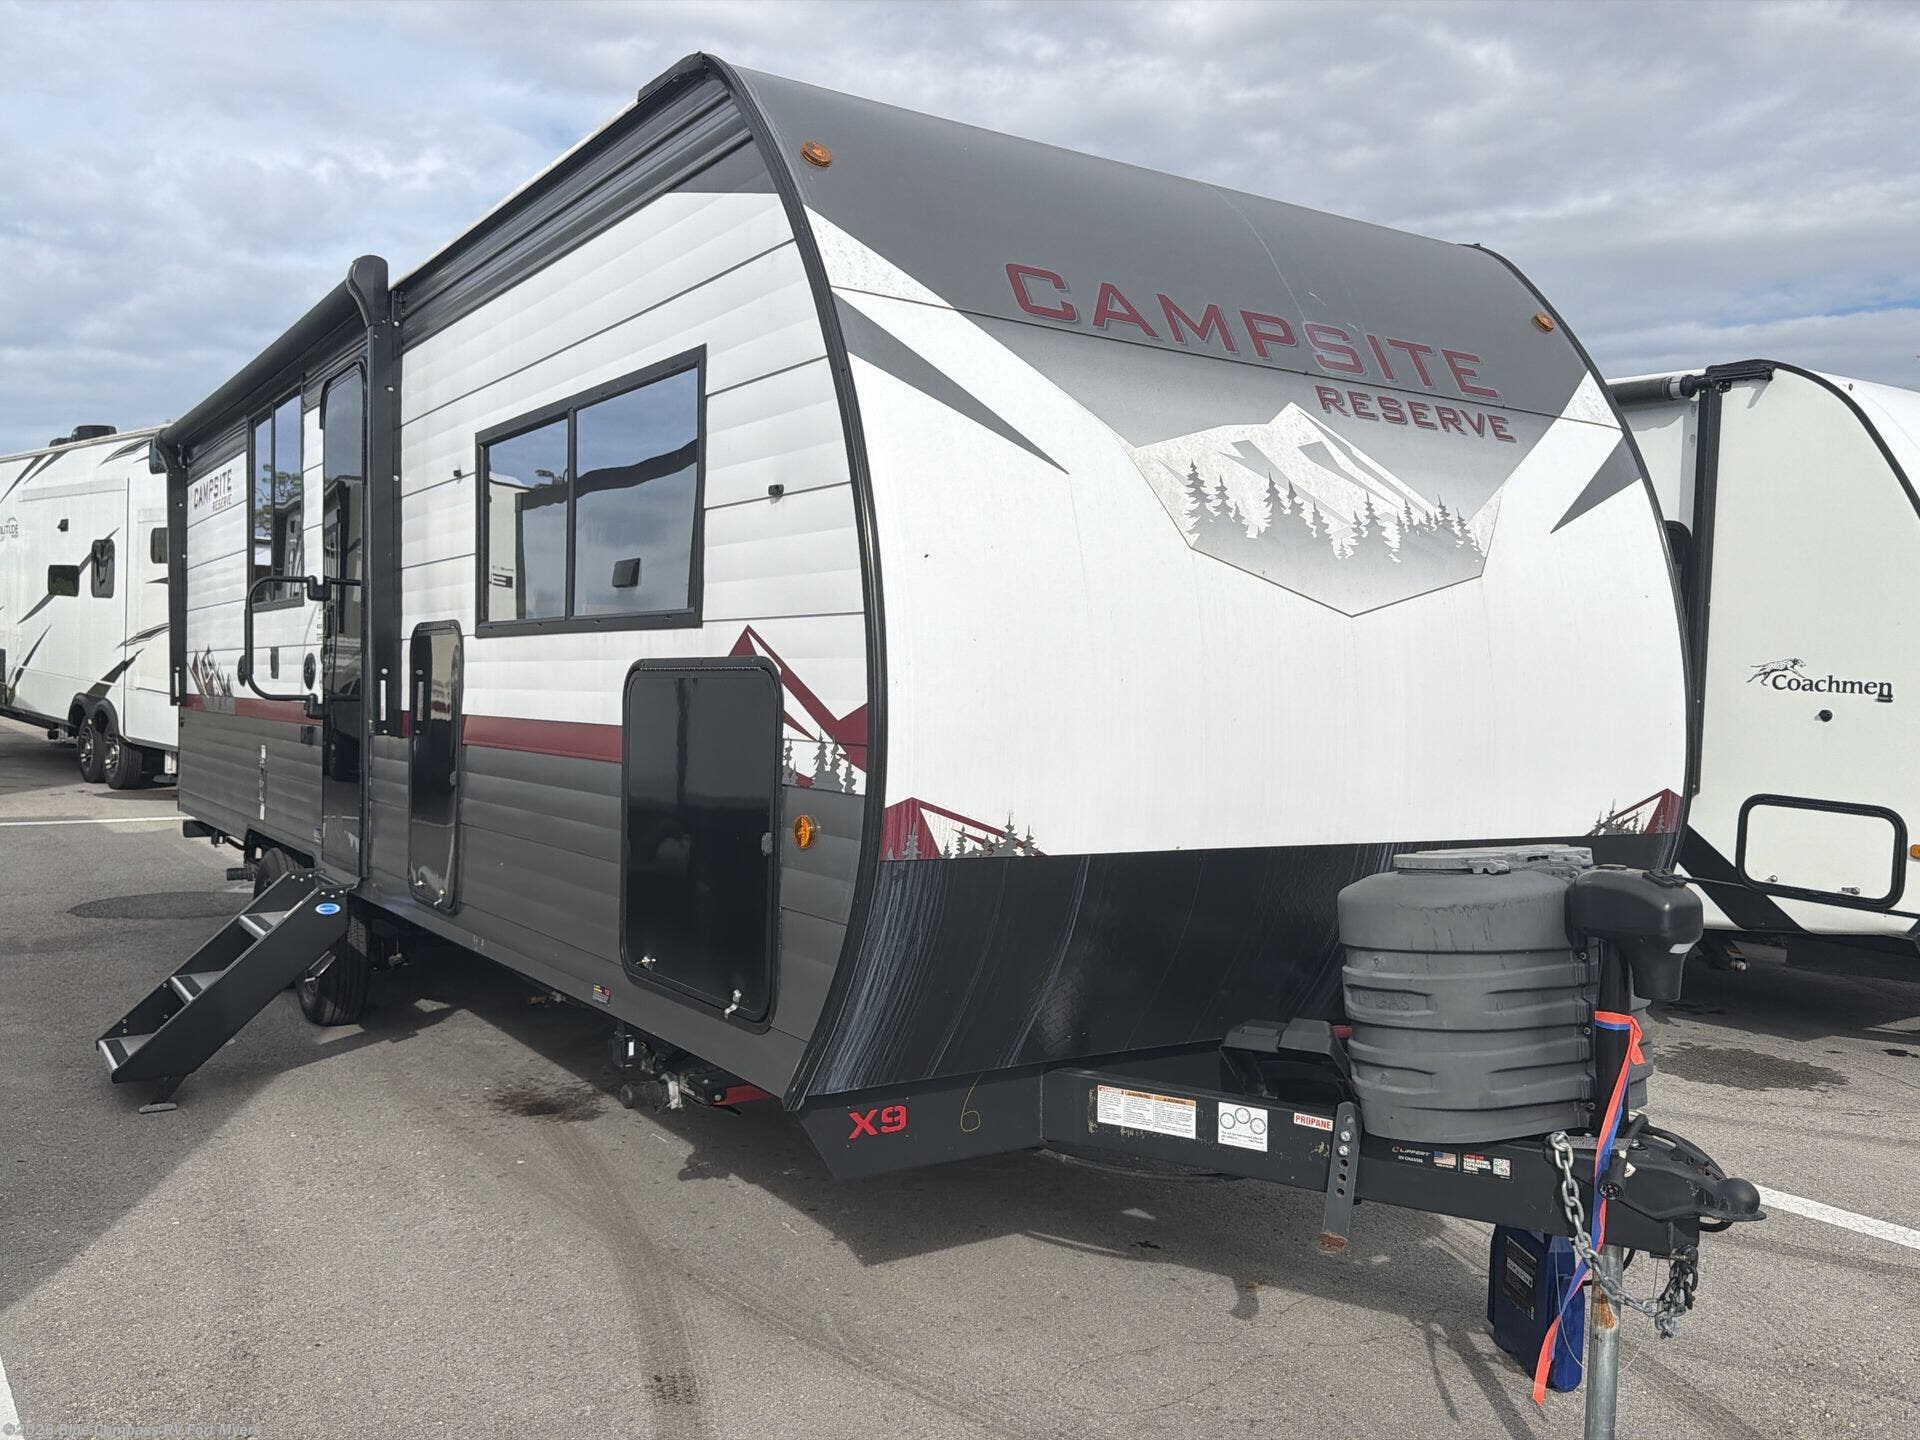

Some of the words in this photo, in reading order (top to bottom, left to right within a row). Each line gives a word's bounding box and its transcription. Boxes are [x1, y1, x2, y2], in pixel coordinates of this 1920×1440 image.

[1005, 263, 1500, 399] CAMPSITE
[1314, 385, 1516, 443] RESERVE
[193, 468, 232, 510] CAMPSITE
[1772, 674, 1893, 696] Coachmen
[848, 1105, 907, 1140] X9
[1295, 1114, 1332, 1130] PROPANE
